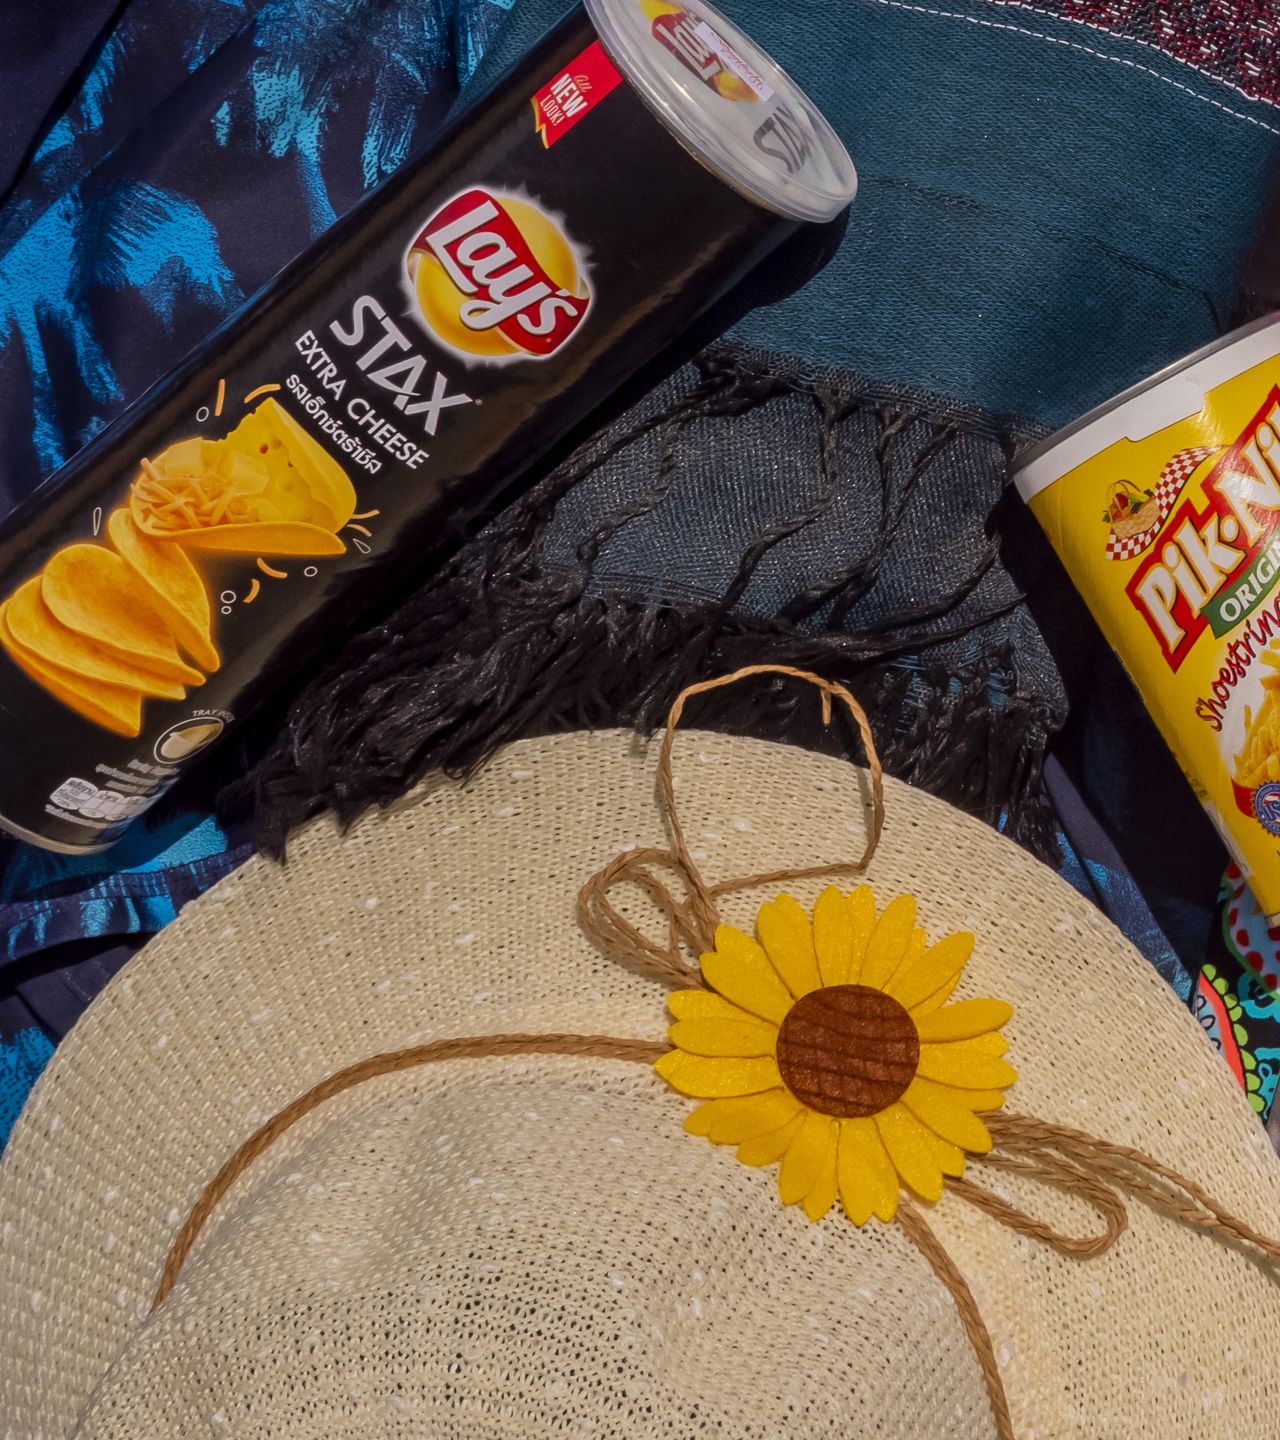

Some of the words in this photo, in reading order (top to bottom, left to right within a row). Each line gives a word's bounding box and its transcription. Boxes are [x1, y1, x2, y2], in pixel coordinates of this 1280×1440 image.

[540, 94, 565, 127] LOOK!
[550, 72, 588, 118] NEW
[425, 199, 579, 336] Lay's
[295, 329, 347, 401] EXTRA
[347, 398, 430, 470] CHEESE
[329, 295, 473, 437] STAX
